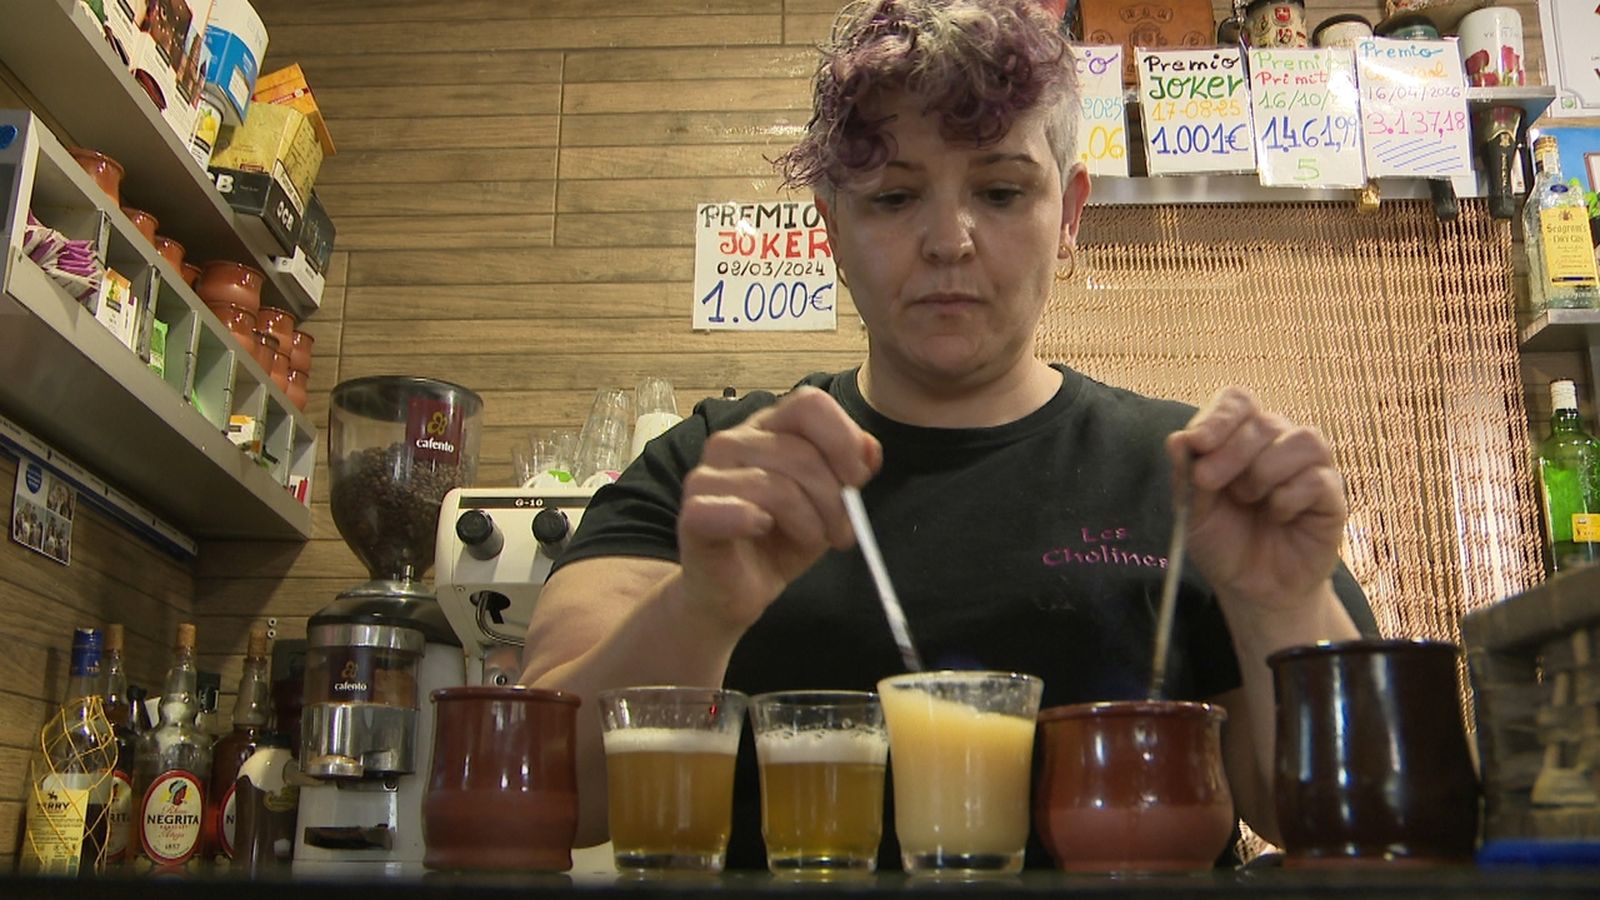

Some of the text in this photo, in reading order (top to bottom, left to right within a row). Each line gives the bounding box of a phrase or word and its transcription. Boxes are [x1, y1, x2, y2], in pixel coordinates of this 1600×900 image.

[1360, 41, 1443, 58] Premio
[1144, 53, 1240, 72] Premio
[1255, 70, 1328, 86] Primit
[1366, 109, 1465, 138] 3.137,18
[1151, 123, 1249, 155] 1.001€
[1294, 158, 1320, 181] 5
[700, 203, 821, 229] PREMIO
[718, 228, 832, 259] JOKER
[702, 280, 834, 323] 1.000€
[416, 437, 455, 453] cafento
[515, 498, 543, 507] G-10
[334, 681, 368, 691] cafento
[147, 814, 200, 825] NEGRITA
